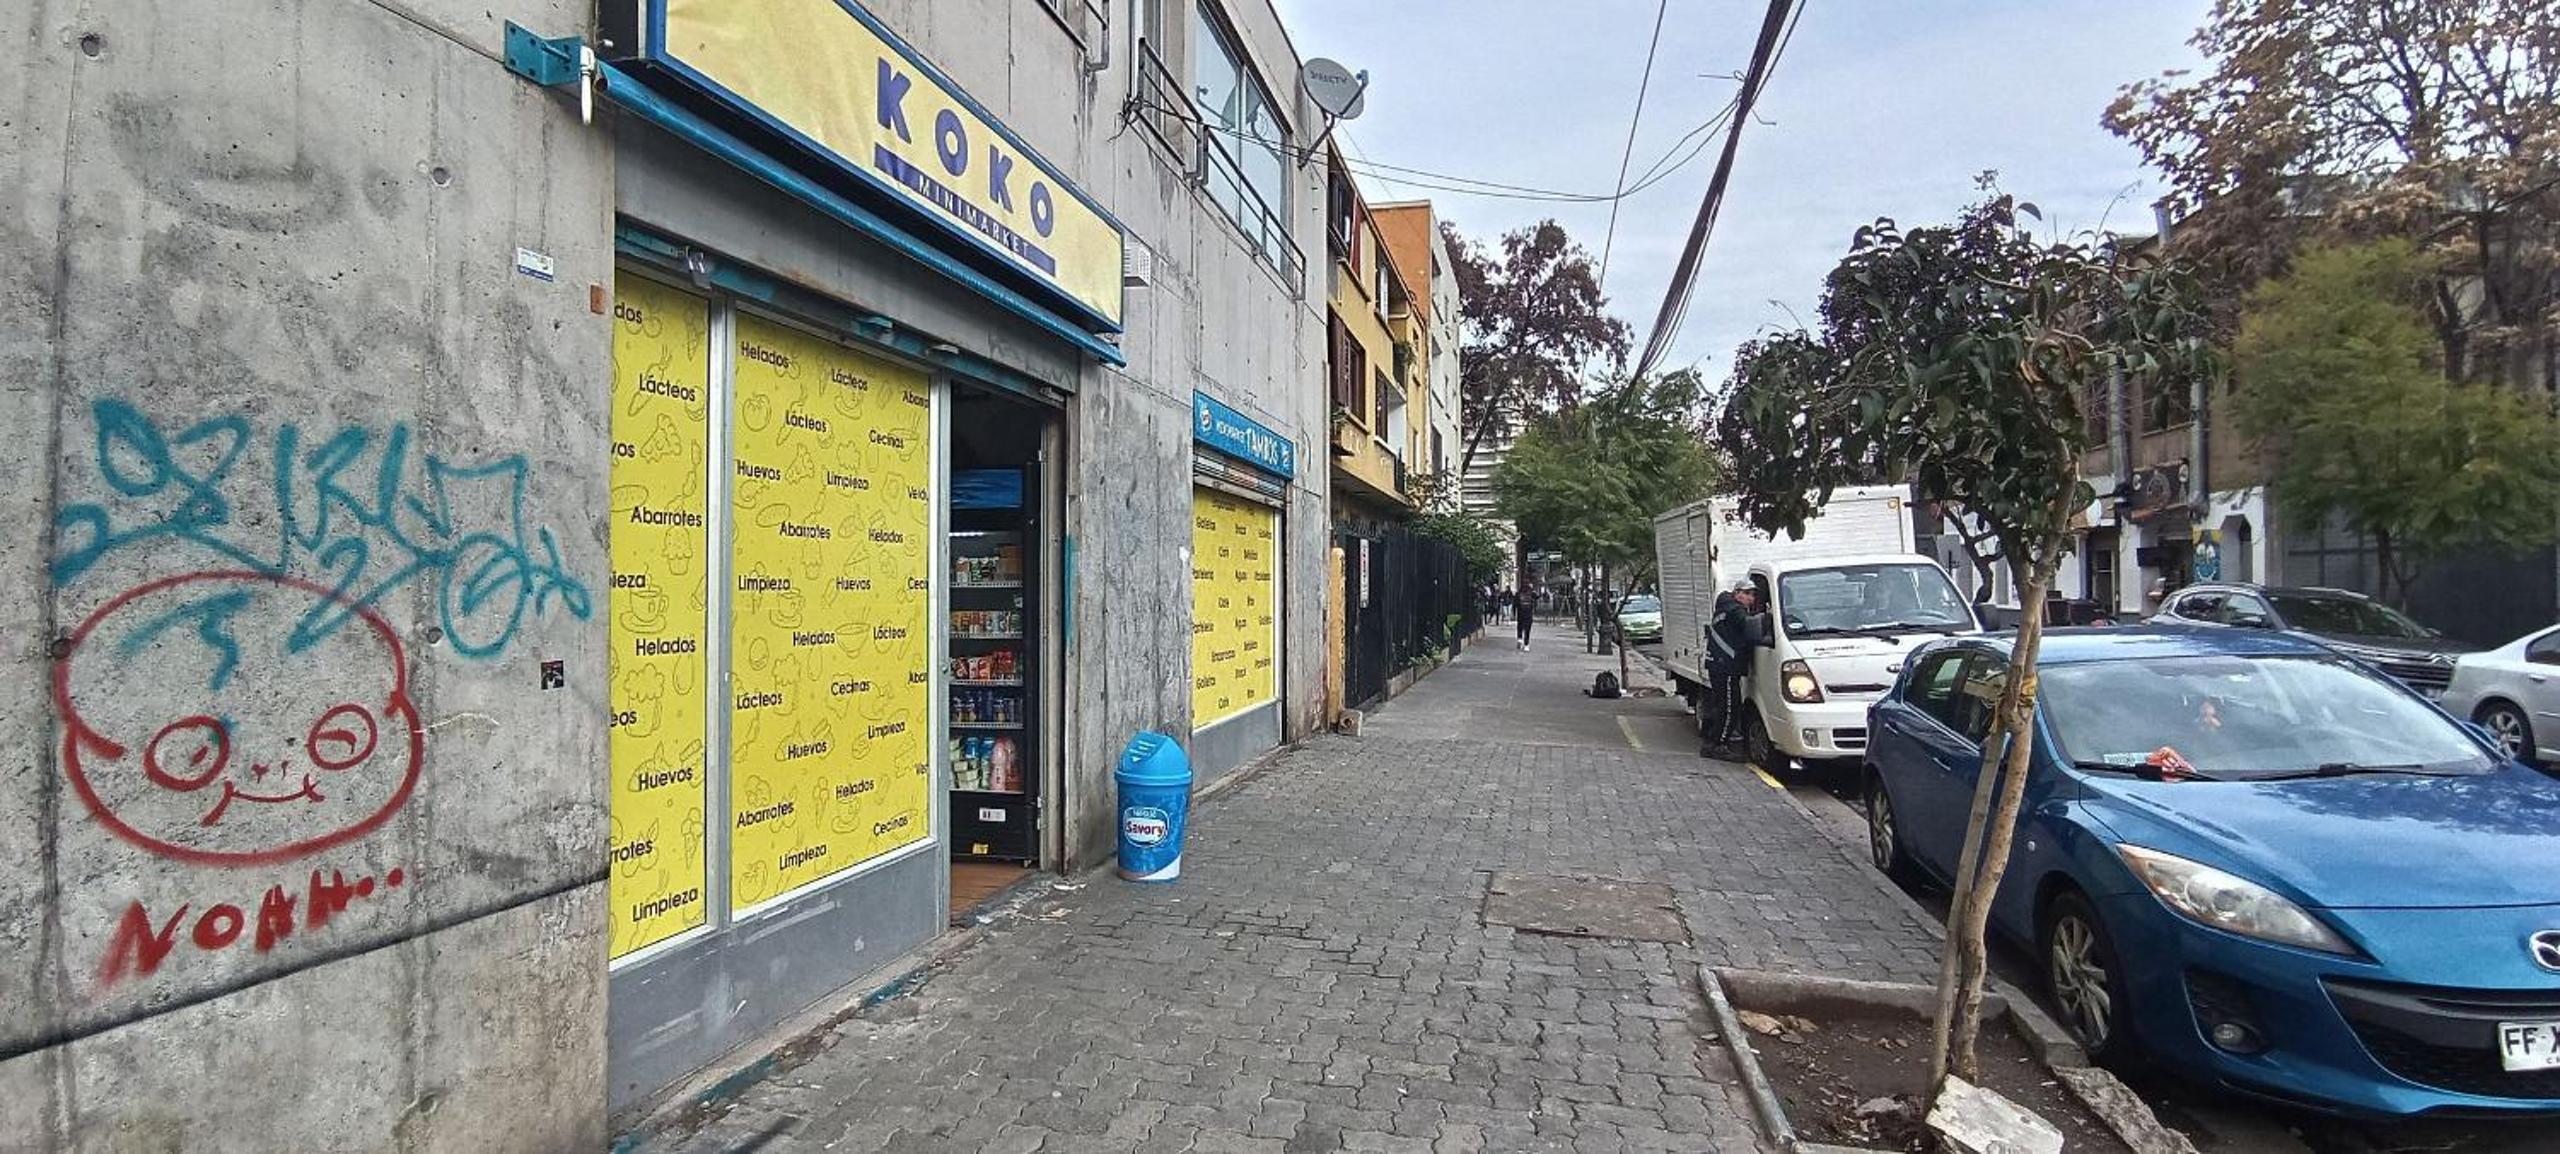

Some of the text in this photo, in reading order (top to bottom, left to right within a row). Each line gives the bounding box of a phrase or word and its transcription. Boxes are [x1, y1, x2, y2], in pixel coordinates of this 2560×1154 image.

[876, 56, 1054, 239] KOKO
[918, 174, 1030, 257] MINIMARKET
[741, 341, 790, 368] Helados
[639, 374, 697, 402] Lácteos
[831, 368, 868, 391] Lácteos
[785, 412, 827, 433] Lácteos
[868, 429, 904, 449] Cecinas
[737, 460, 781, 481] Huevos
[827, 470, 869, 491] Limpieza
[631, 505, 702, 527] Abarrotes
[780, 520, 831, 540] Abarrotes
[868, 528, 904, 544] Helados
[609, 571, 646, 588] ieza
[738, 575, 791, 593] Limpieza
[836, 576, 871, 591] Huevos
[793, 631, 835, 647] Helados
[873, 626, 906, 640] Lácteos
[635, 637, 696, 657] Helados
[830, 680, 870, 696] Cecinas
[736, 692, 783, 710] Lácteos
[868, 719, 905, 740] Limpieza
[788, 740, 827, 760] Huevos
[638, 767, 693, 792] Huevos
[835, 779, 874, 800] Helados
[736, 801, 794, 829] Abarrotes
[873, 816, 909, 837] Cecinas
[1126, 821, 1164, 838] Savory
[779, 843, 827, 871] Limpieza
[632, 888, 699, 923] Limpieza
